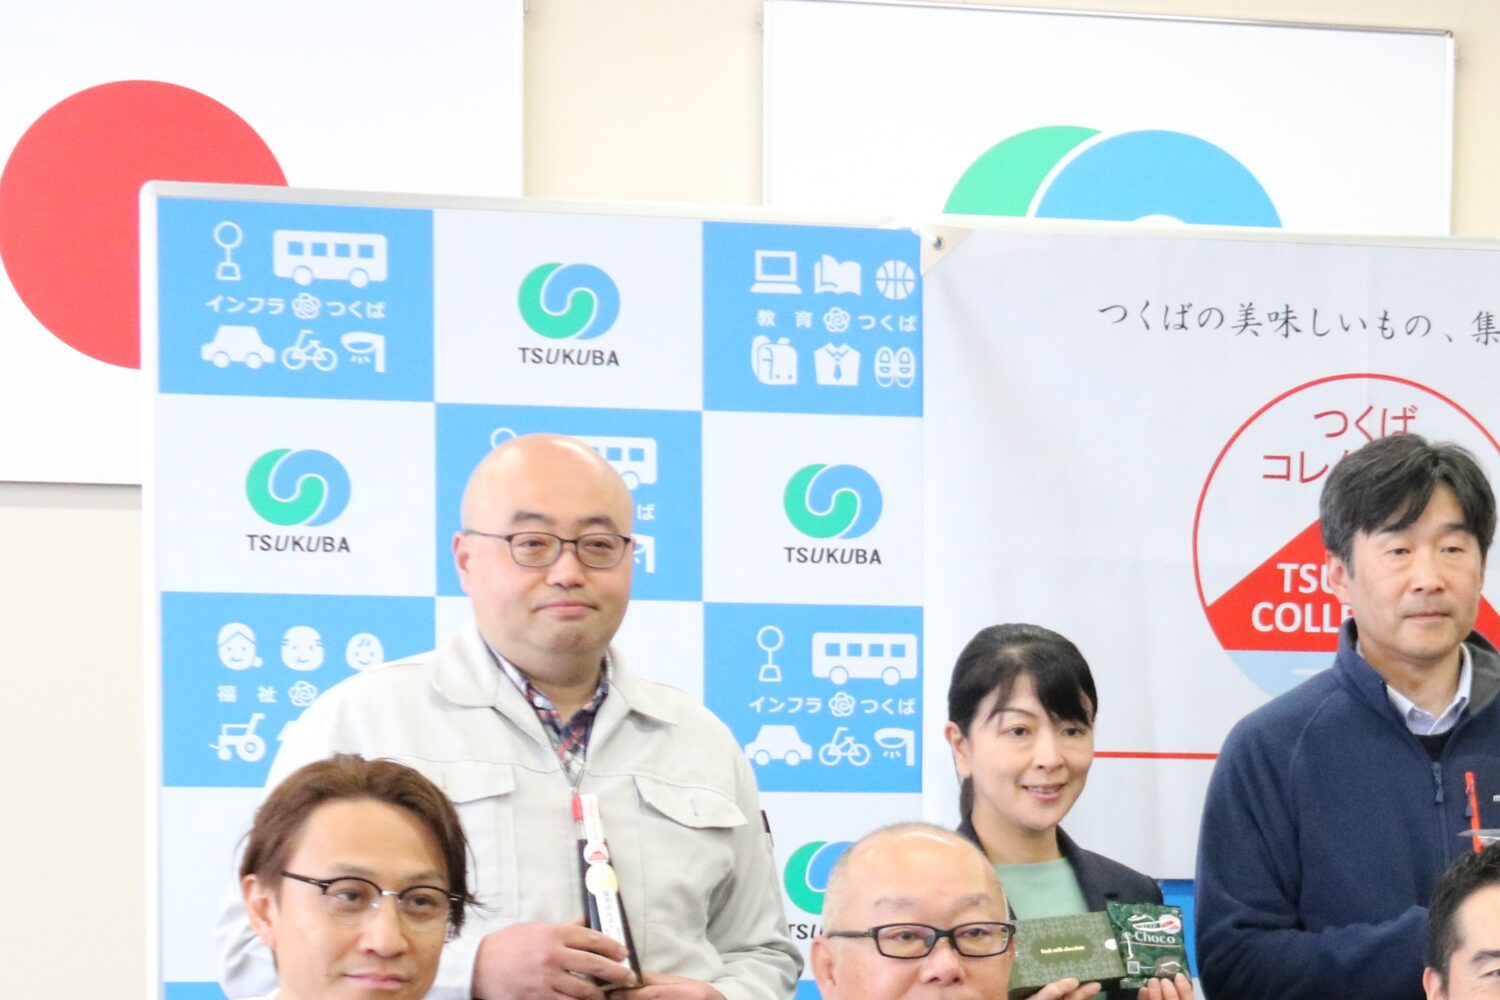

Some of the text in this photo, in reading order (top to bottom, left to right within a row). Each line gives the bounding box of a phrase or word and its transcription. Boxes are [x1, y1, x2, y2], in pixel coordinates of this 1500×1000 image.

[205, 295, 386, 319] インフラ つくば
[857, 314, 917, 333] つくば
[518, 347, 620, 367] TSUKUBA
[1314, 404, 1418, 441] つくば
[1263, 450, 1350, 483] コレ
[245, 534, 351, 553] TSUKUBA
[783, 546, 882, 565] TSUKUBA
[749, 696, 916, 715] インフラ つくば
